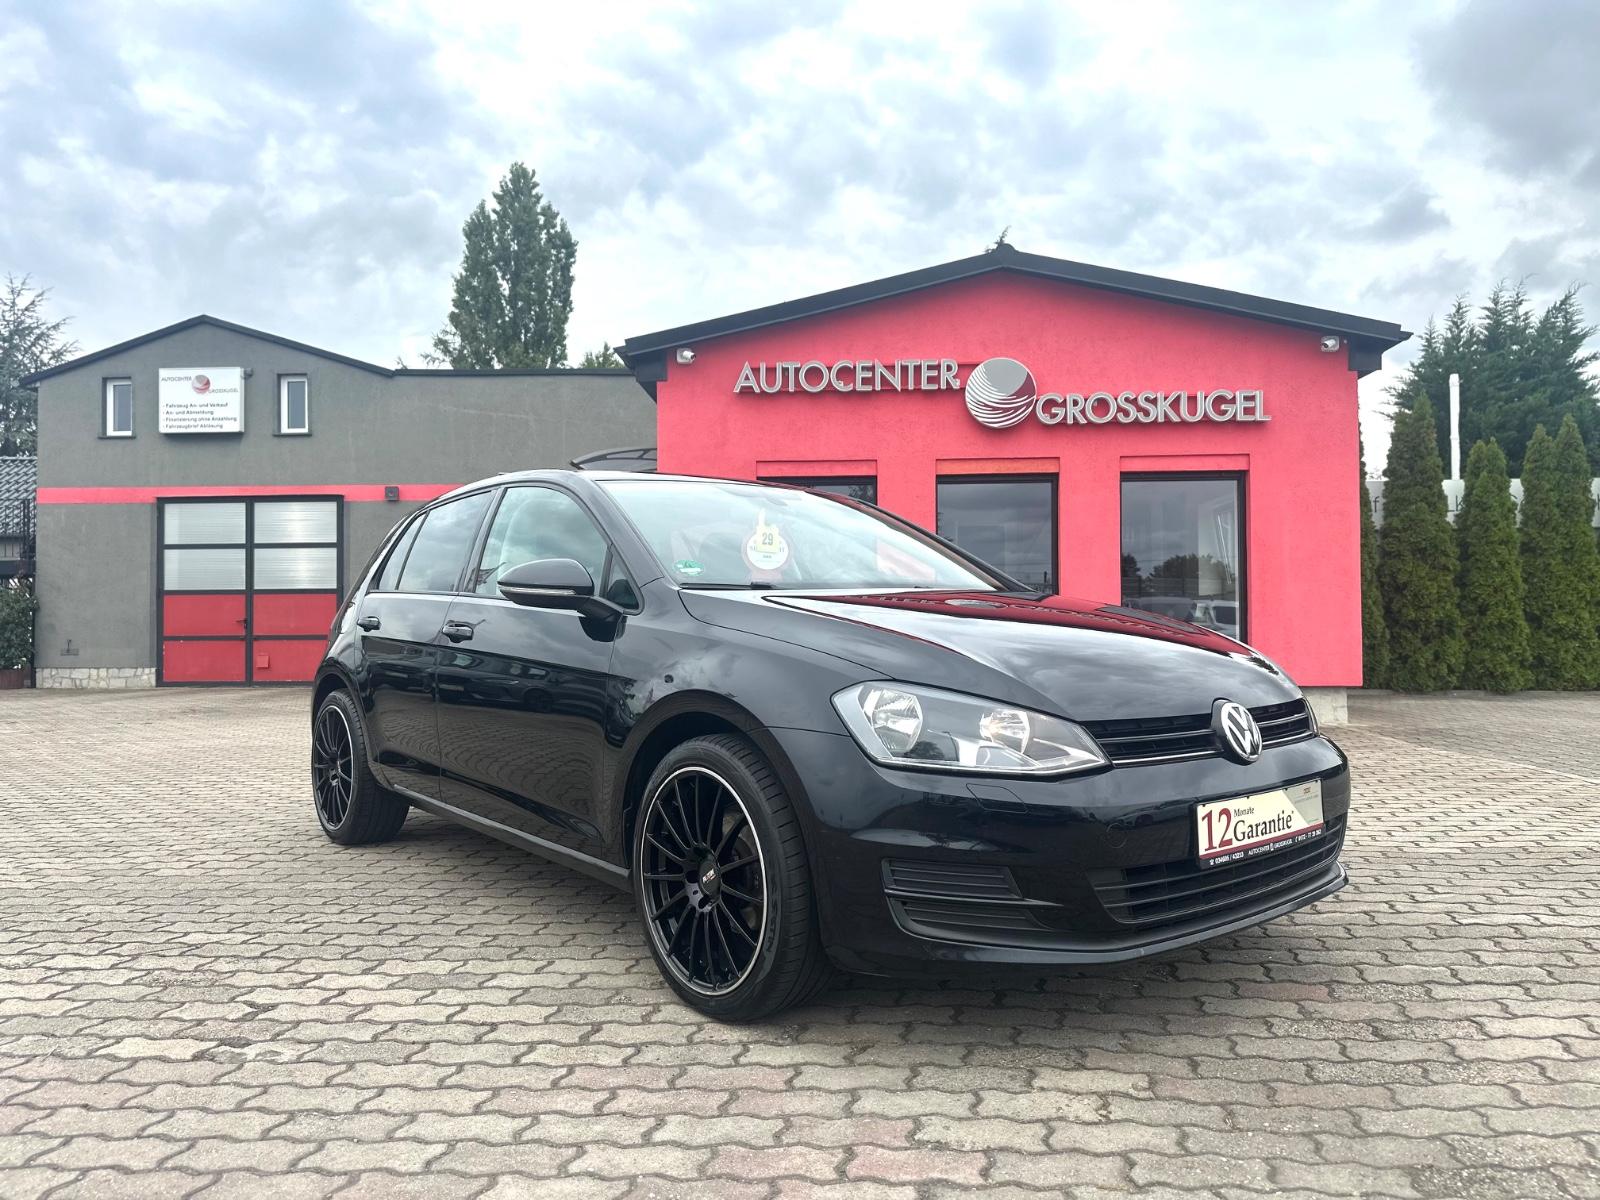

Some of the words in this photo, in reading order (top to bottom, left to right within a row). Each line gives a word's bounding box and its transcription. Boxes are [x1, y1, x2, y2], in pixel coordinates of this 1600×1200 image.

[733, 359, 960, 393] AUTOCENTER
[1035, 389, 1272, 424] GROSSKUGEL
[762, 532, 774, 546] 29
[1233, 806, 1255, 818] Monate
[1201, 807, 1233, 852] 12
